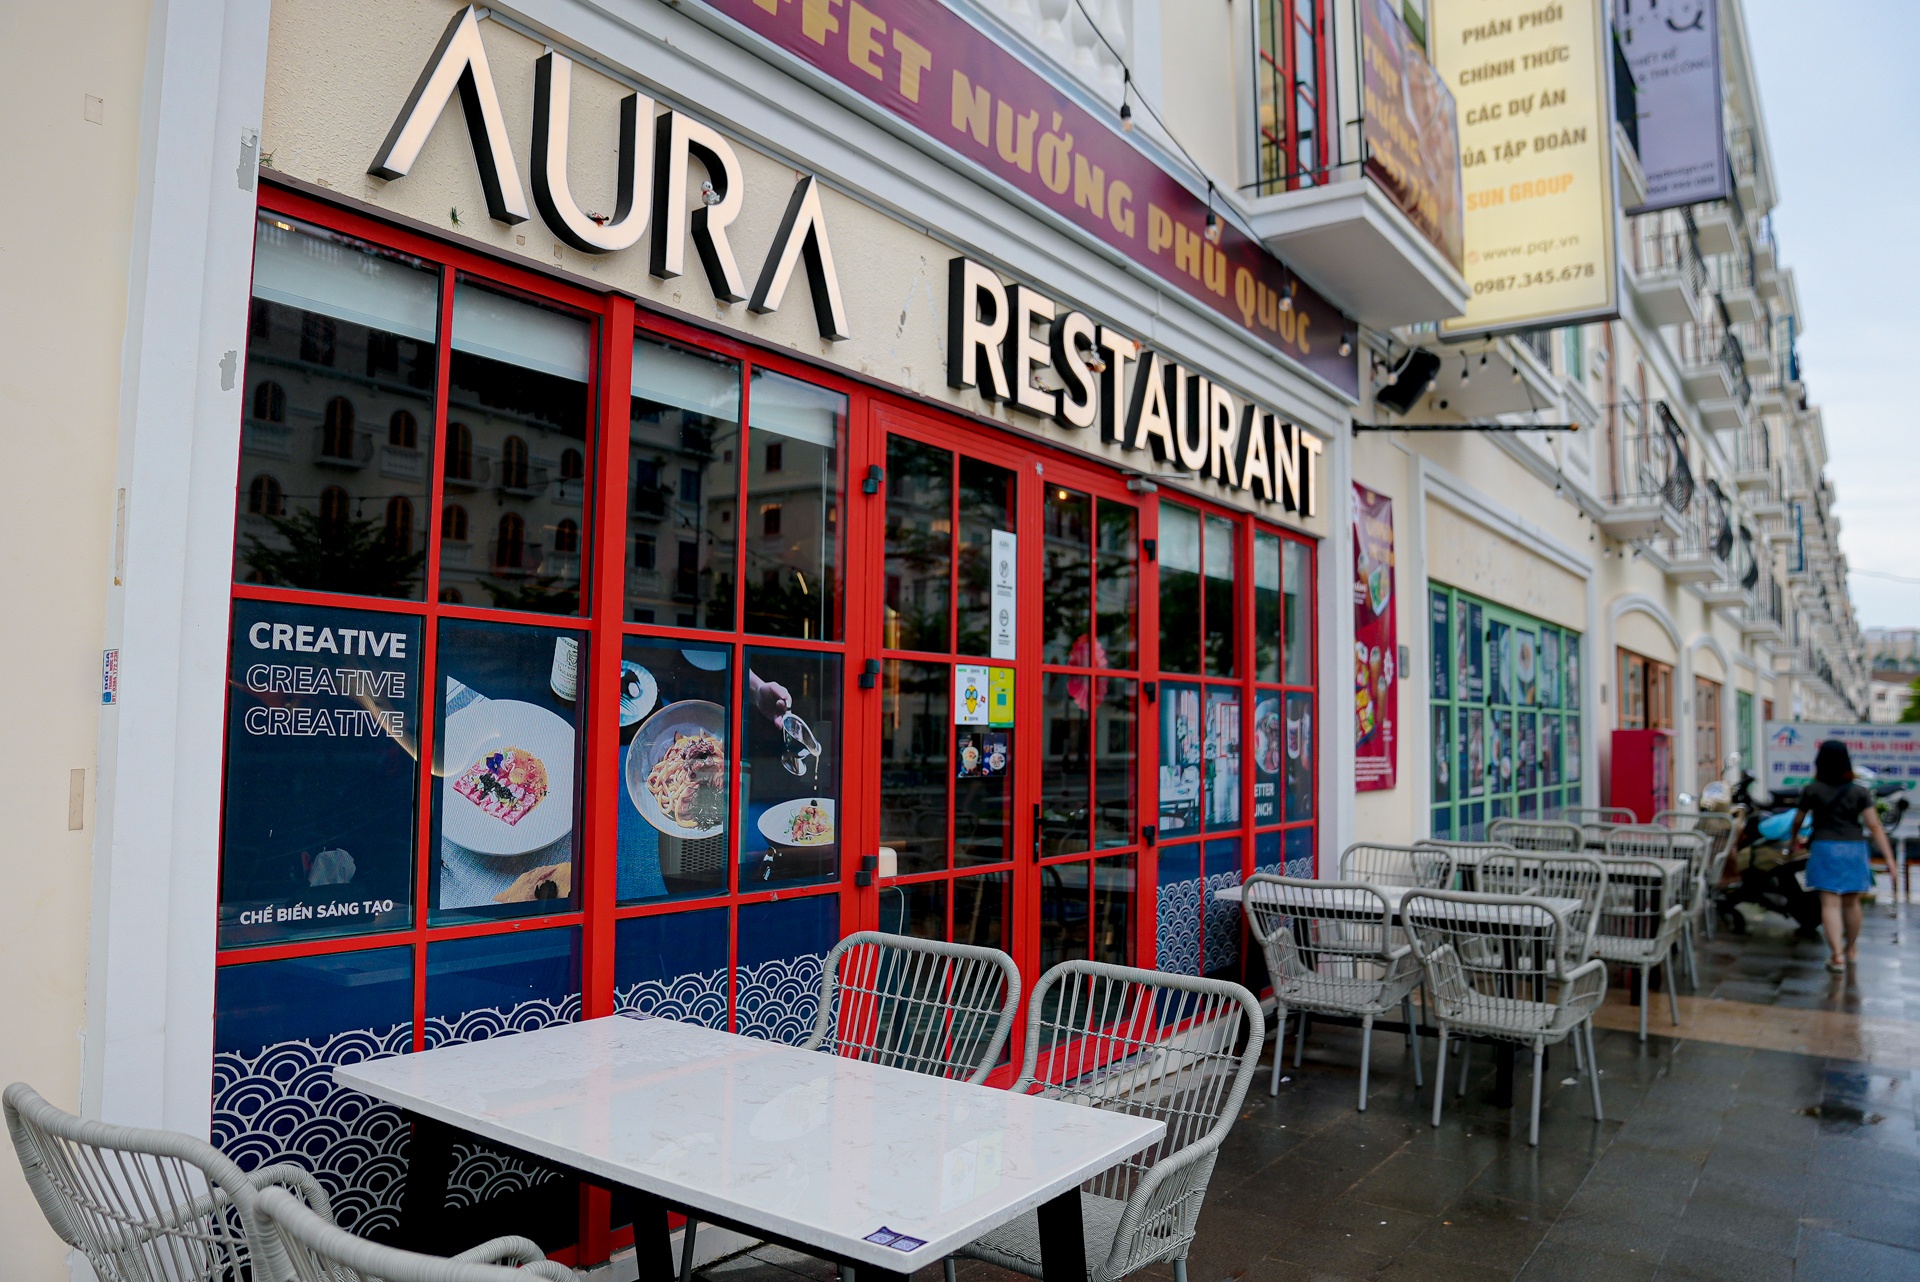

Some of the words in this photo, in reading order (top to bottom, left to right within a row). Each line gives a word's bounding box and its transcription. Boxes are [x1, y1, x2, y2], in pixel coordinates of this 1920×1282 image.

[1462, 18, 1513, 45] PHÂN
[1518, 1, 1564, 31] PHỐI
[1459, 58, 1515, 87] CHÍNH
[1521, 44, 1570, 71] THỨC
[1466, 102, 1502, 127] CÁC
[1508, 92, 1535, 118] DỰ
[1539, 88, 1566, 109] ÁN
[951, 69, 1135, 239] NƯỚNG
[1462, 147, 1487, 169] ỦA
[1492, 138, 1527, 164] TẬP
[1533, 127, 1587, 153] ĐOÀN
[1466, 187, 1505, 212] SUN
[1509, 172, 1575, 203] GROUP
[368, 4, 850, 342] AURA
[947, 256, 1322, 518] RESTAURANT
[1482, 234, 1580, 261] www.pqr.vn
[1474, 262, 1596, 296] 0987.345.678
[249, 622, 407, 658] CREATIVE
[246, 664, 405, 698] CREATIVE
[244, 706, 404, 738] CREATIVE
[1254, 783, 1275, 797] ETTER
[239, 904, 274, 925] CHẾ
[276, 902, 313, 922] BIẾN
[316, 901, 359, 918] SÁNG
[362, 899, 394, 916] TẠO
